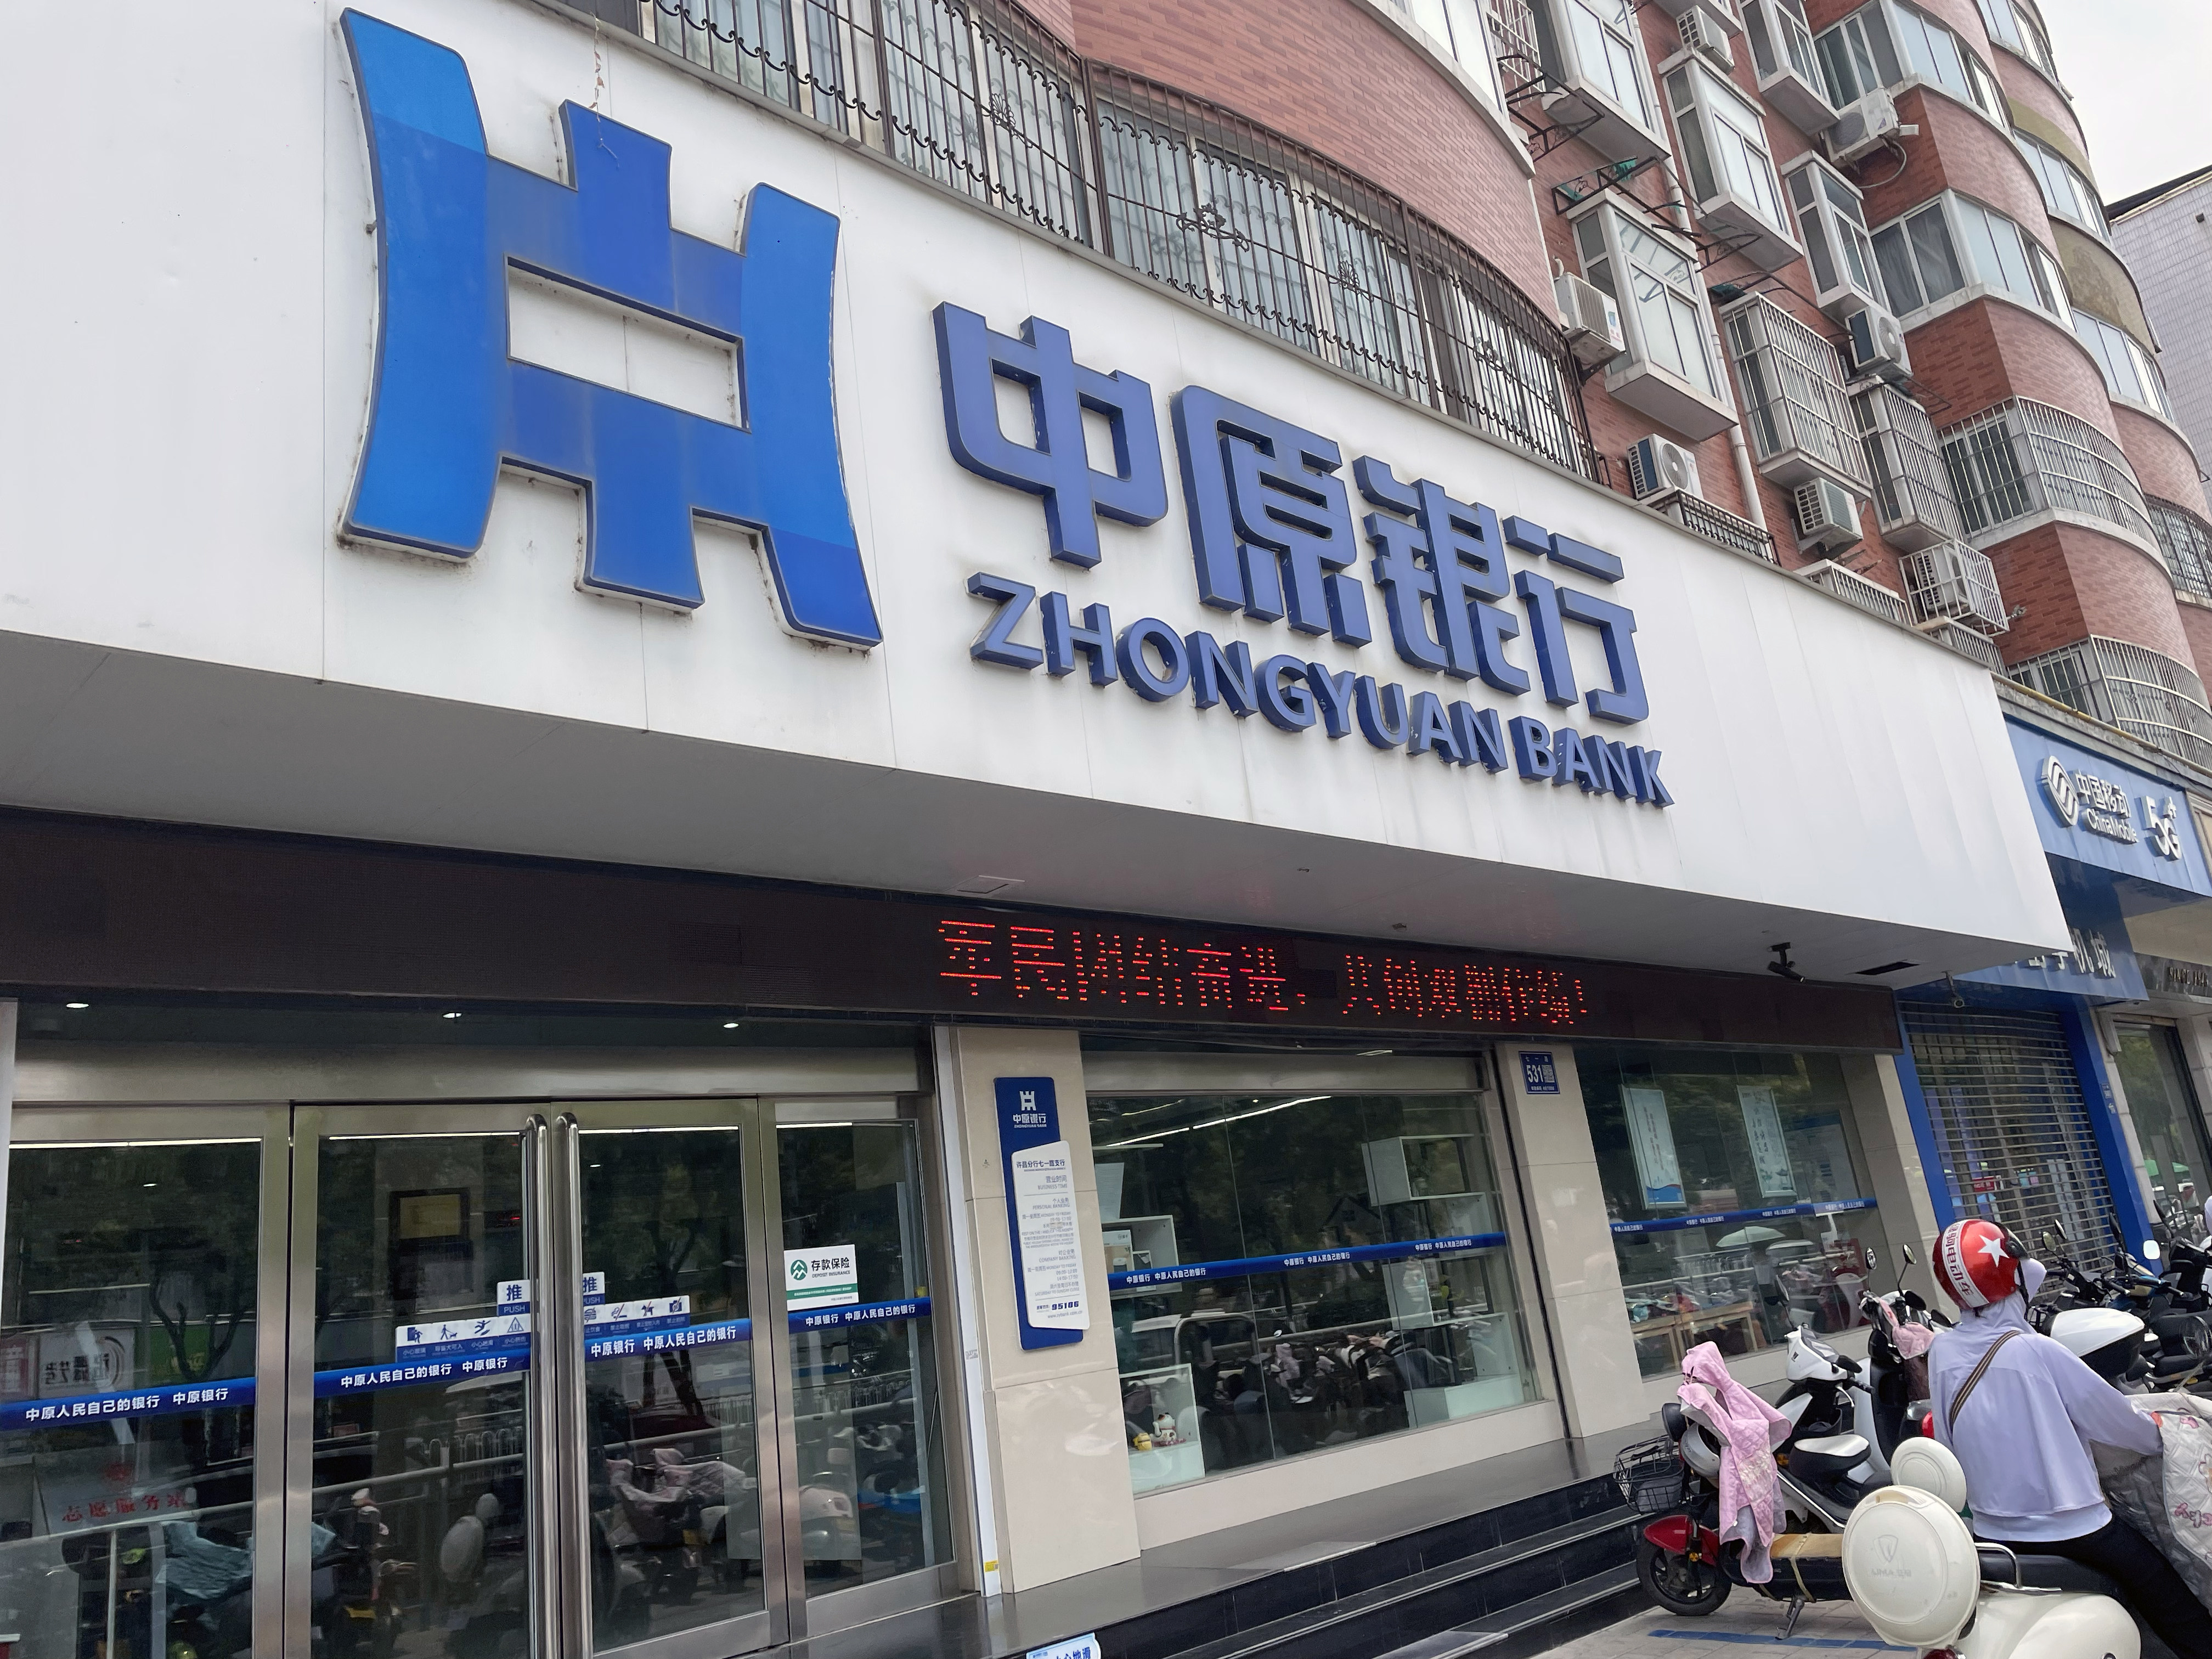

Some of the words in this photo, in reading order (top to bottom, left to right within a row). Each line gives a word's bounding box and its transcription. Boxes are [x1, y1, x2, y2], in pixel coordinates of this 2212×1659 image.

[932, 302, 1649, 725] 中原银行
[967, 571, 1508, 772] ZHONGYUAN
[1508, 715, 1676, 808] BANK
[2074, 768, 2131, 819] 中国移动
[1526, 1064, 1544, 1083] 531
[1013, 1113, 1046, 1124] 中原银行
[811, 1257, 850, 1271] 存款保险
[583, 1277, 597, 1293] 推
[1126, 1274, 1151, 1285] 中原银行
[1154, 1267, 1206, 1281] 中原人民自己的银行
[506, 1284, 522, 1301] 推
[504, 1305, 526, 1313] PUSH
[805, 1313, 839, 1327] 中原银行
[845, 1304, 916, 1321] 中原人民自己的银行
[591, 1339, 635, 1358] 中原银行
[644, 1325, 736, 1351] 中原人民自己的银行
[341, 1363, 452, 1388] 中原人民自己的银行
[462, 1357, 508, 1373] 中原银行
[26, 1395, 160, 1422] 中原人民自己的银行
[173, 1388, 228, 1406] 中原银行
